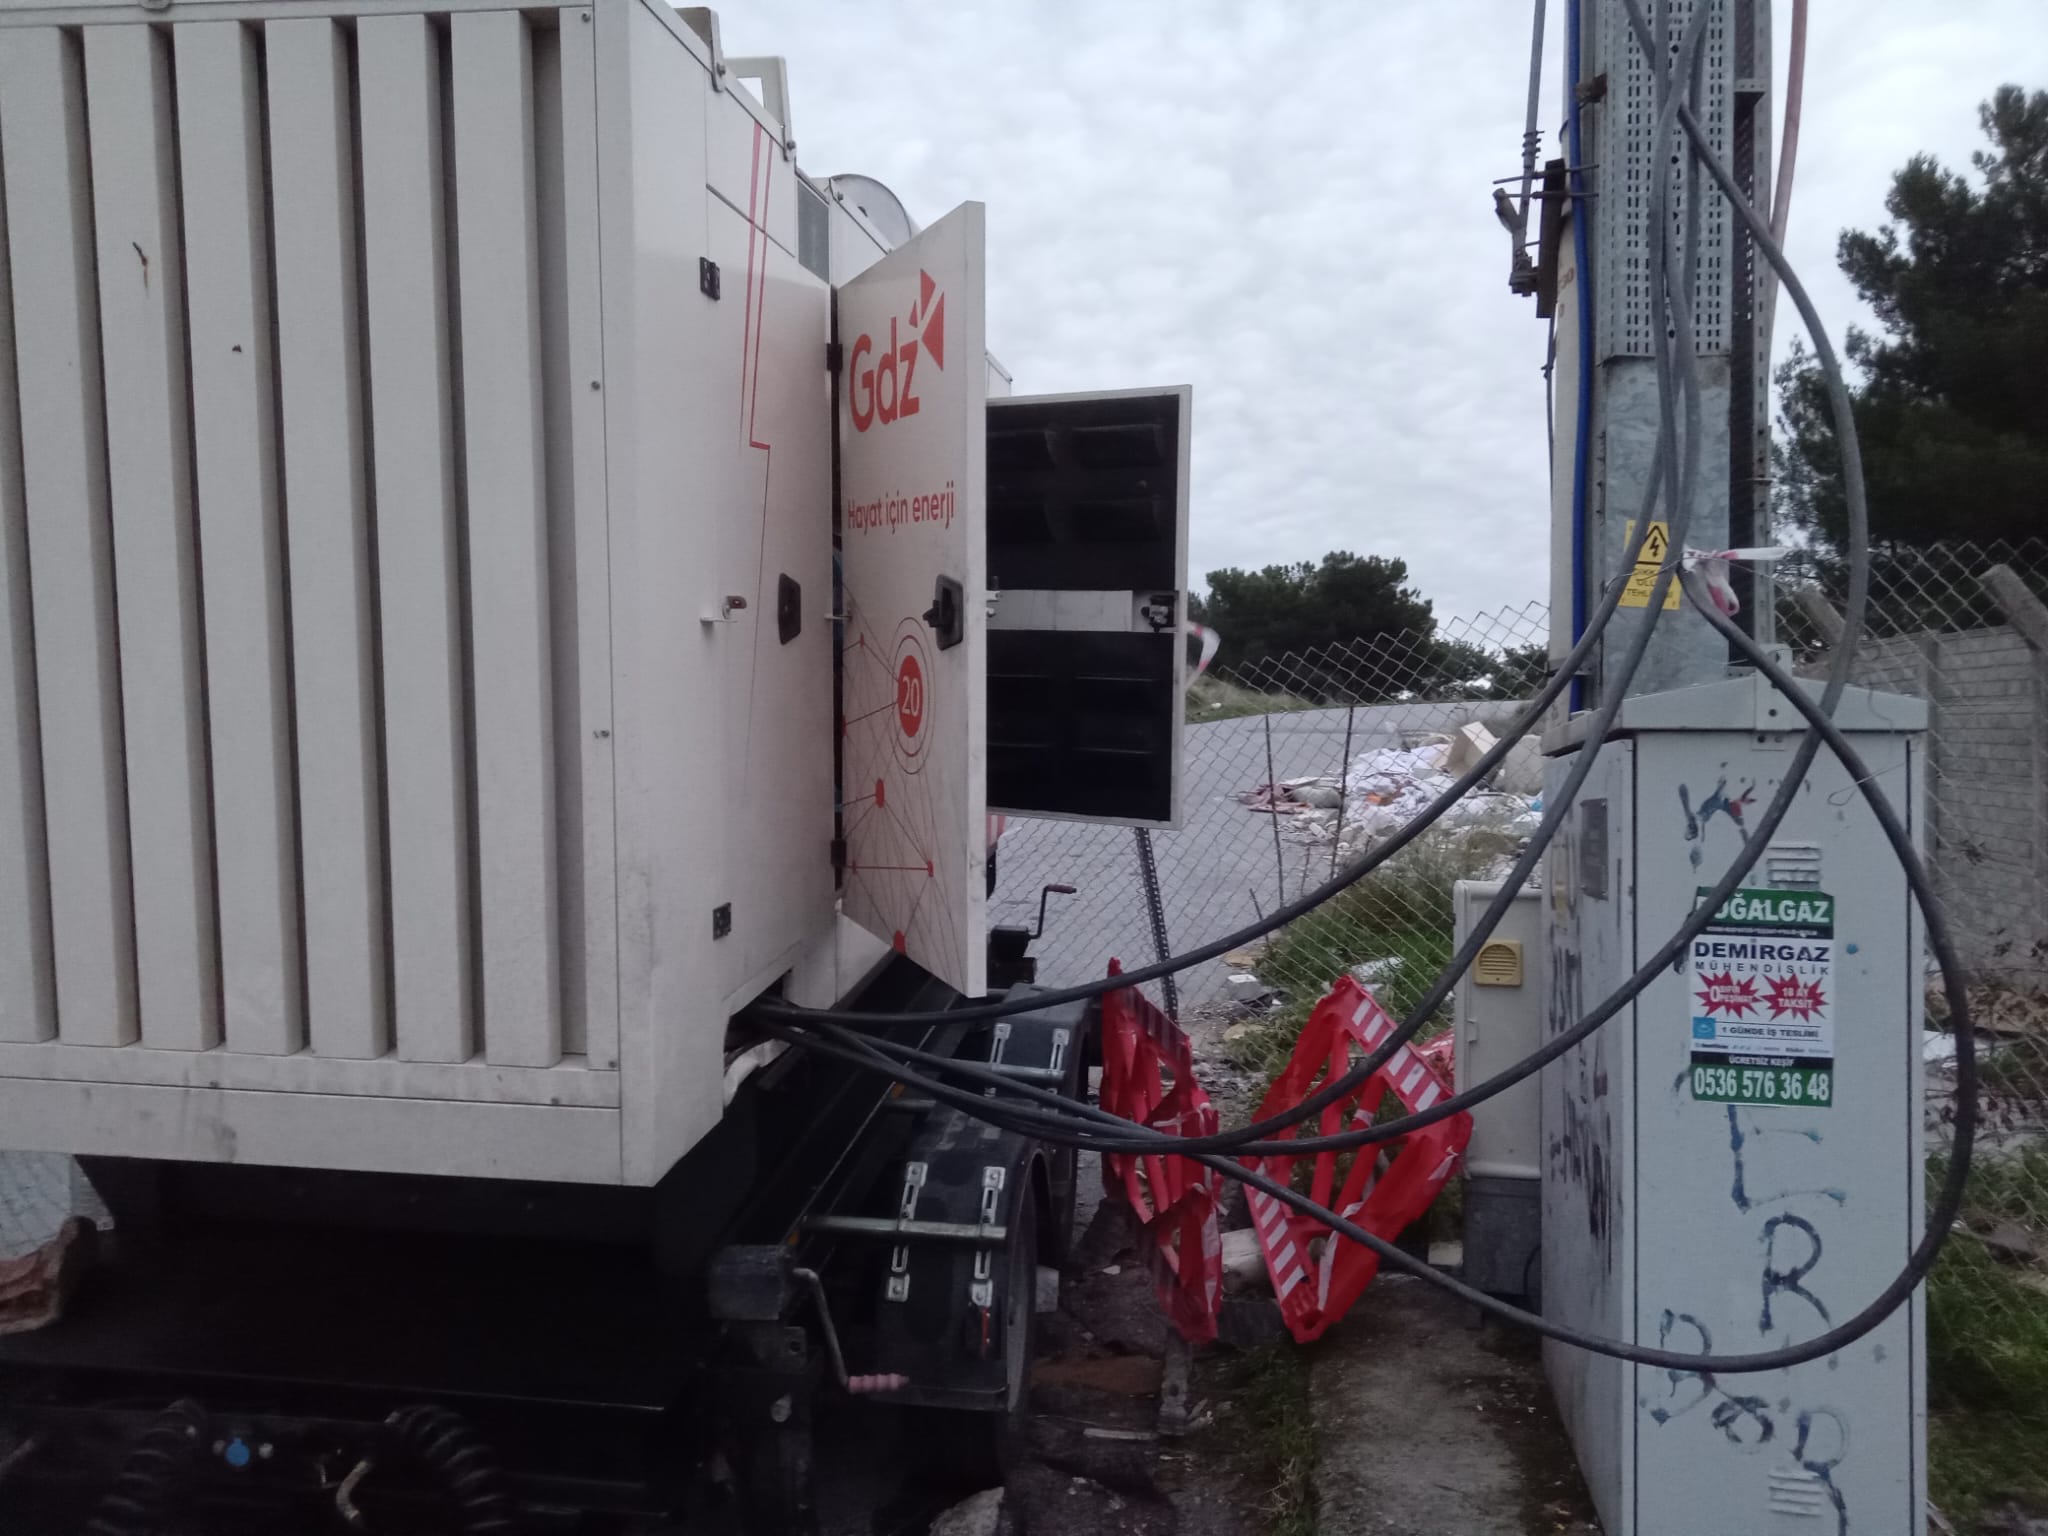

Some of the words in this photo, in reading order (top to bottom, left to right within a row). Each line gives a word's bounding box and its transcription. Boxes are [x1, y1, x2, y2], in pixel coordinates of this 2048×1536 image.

[849, 316, 919, 433] Gdz
[847, 498, 882, 536] Hayat
[886, 489, 908, 535] için
[912, 480, 954, 530] enerji
[901, 675, 921, 717] 20
[1695, 938, 1830, 962] DEMİRGAZ
[1696, 960, 1829, 975] MÜHENDİSLİK
[1709, 985, 1721, 1002] 0
[1694, 1067, 1737, 1097] 0536
[1742, 1070, 1776, 1099] 576
[1780, 1072, 1803, 1100] 36
[1807, 1073, 1830, 1102] 48
